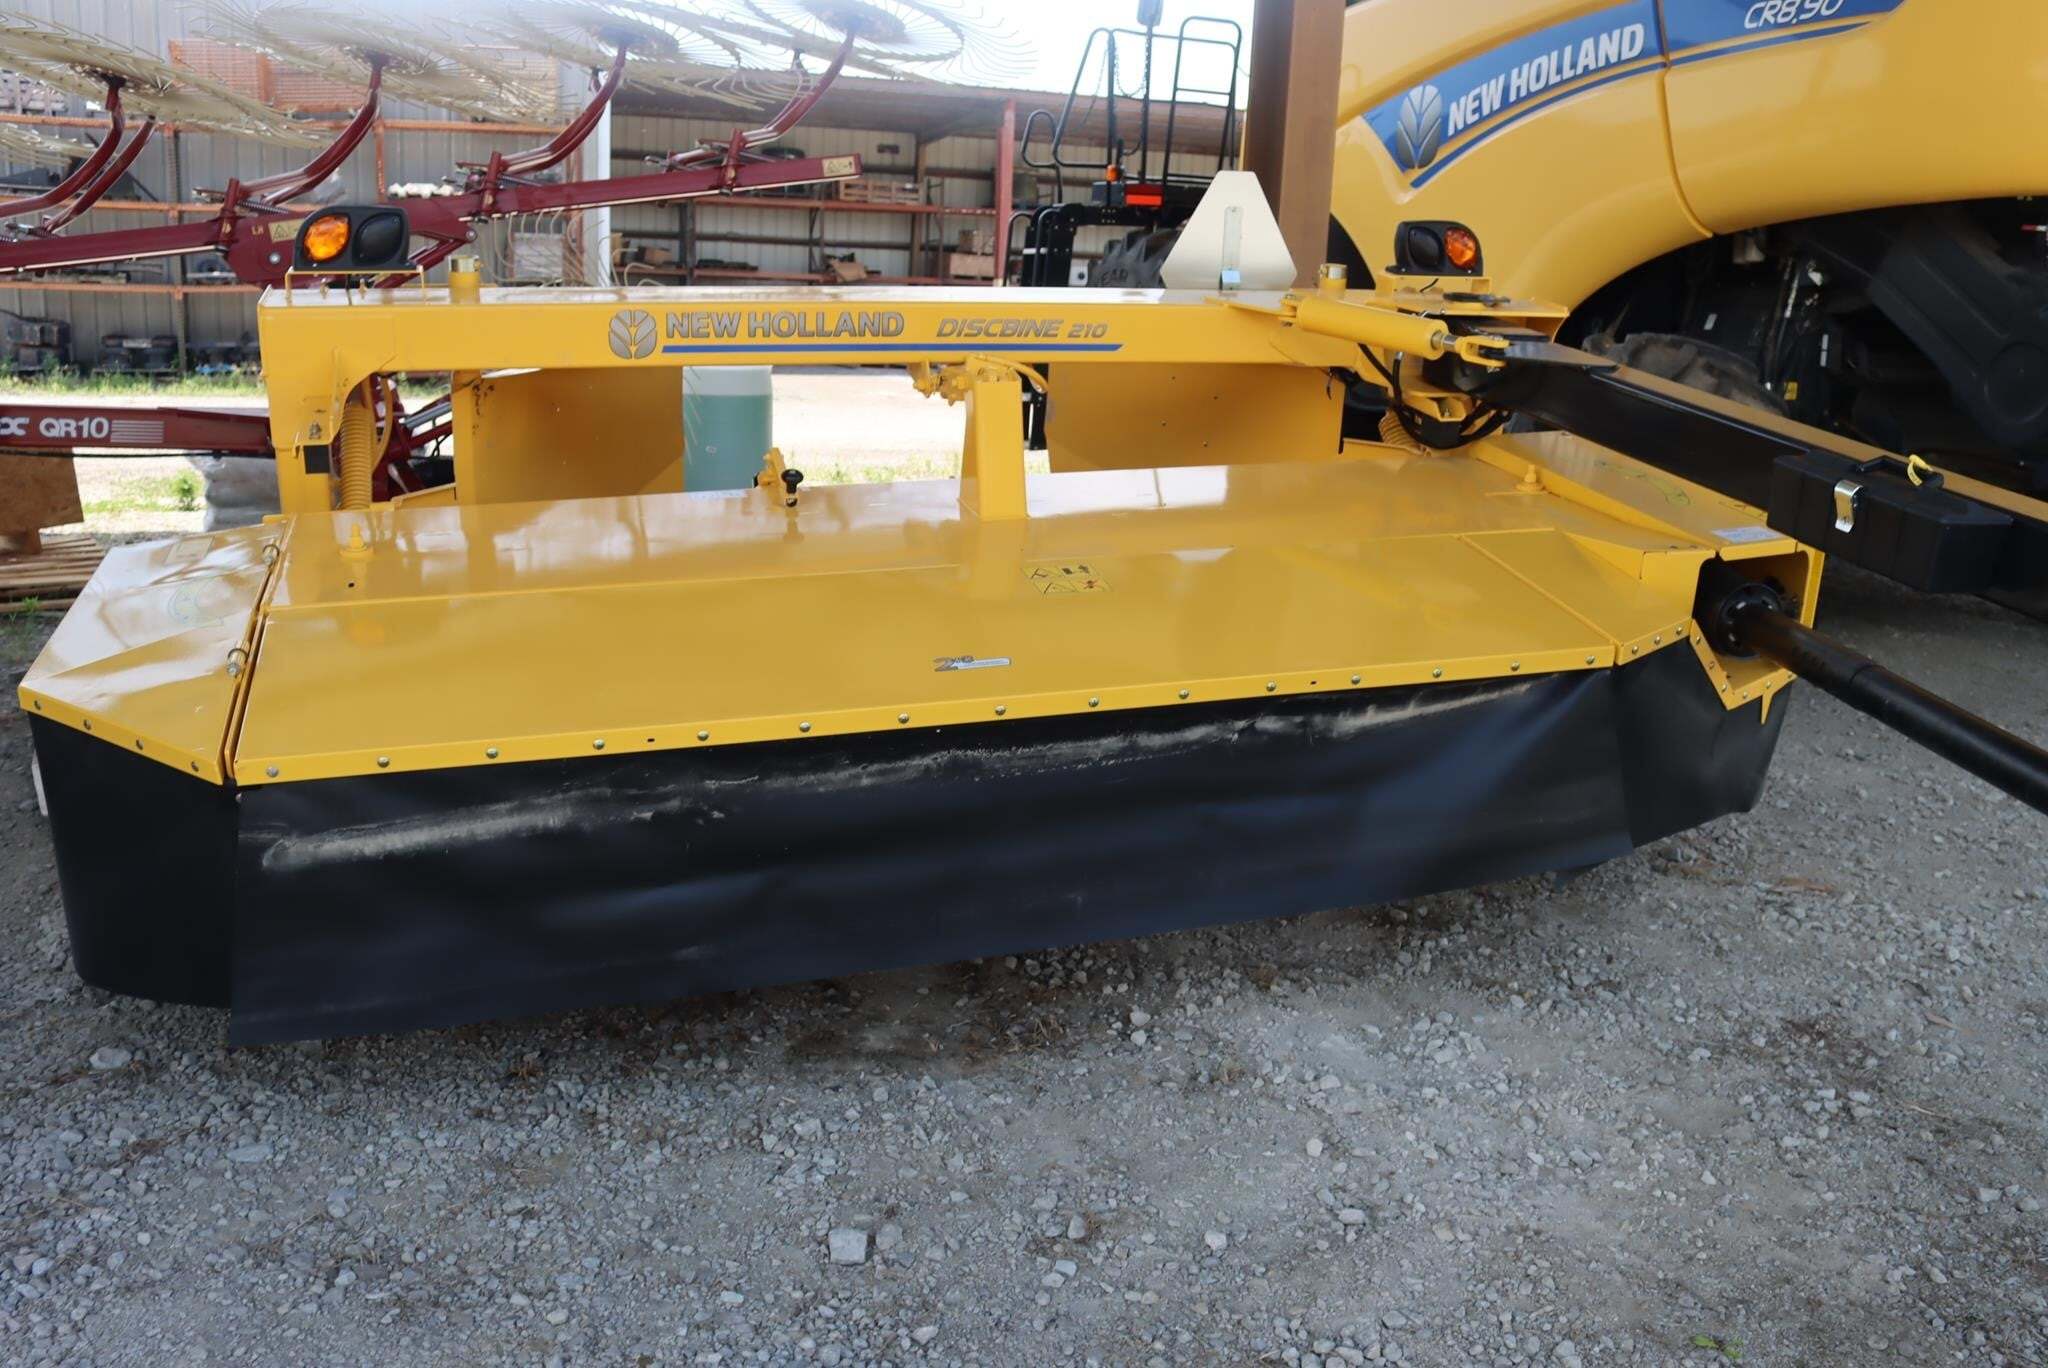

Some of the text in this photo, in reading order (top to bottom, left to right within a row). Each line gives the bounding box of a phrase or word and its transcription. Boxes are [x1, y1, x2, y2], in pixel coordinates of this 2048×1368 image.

[1744, 0, 1844, 29] CR8.90
[1448, 22, 1645, 138] NEW HOLLAND
[666, 311, 905, 338] NEW HOLLAND
[936, 318, 1108, 338] DISCBINE 210
[39, 416, 110, 438] QR10
